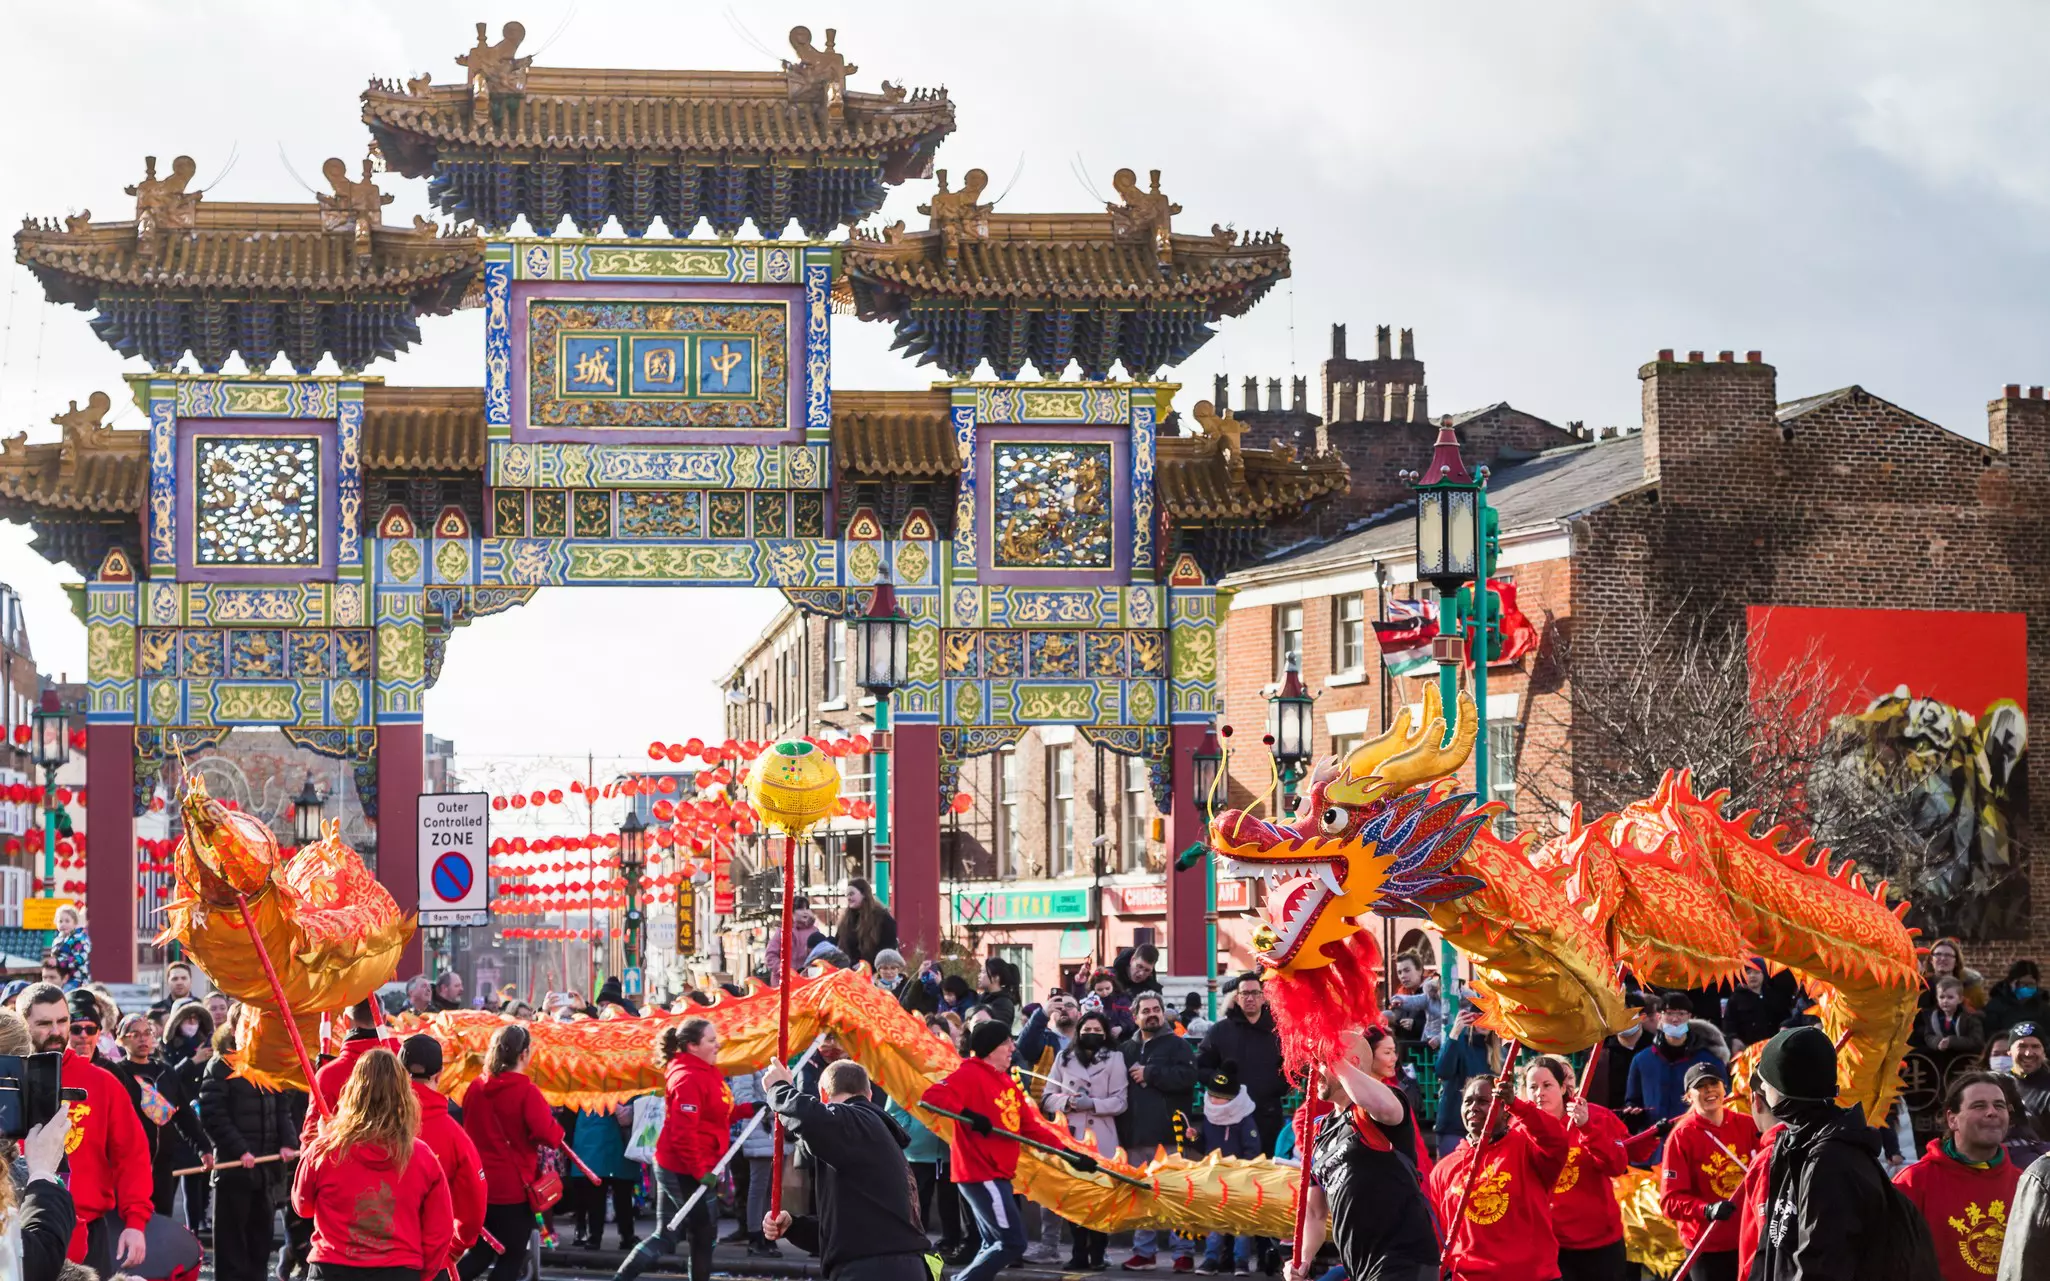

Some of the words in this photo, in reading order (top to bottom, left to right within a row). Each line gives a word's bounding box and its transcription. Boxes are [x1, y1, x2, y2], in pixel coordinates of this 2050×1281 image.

[437, 802, 469, 814] Outer
[423, 816, 482, 828] Controlled
[431, 832, 474, 846] ZONE
